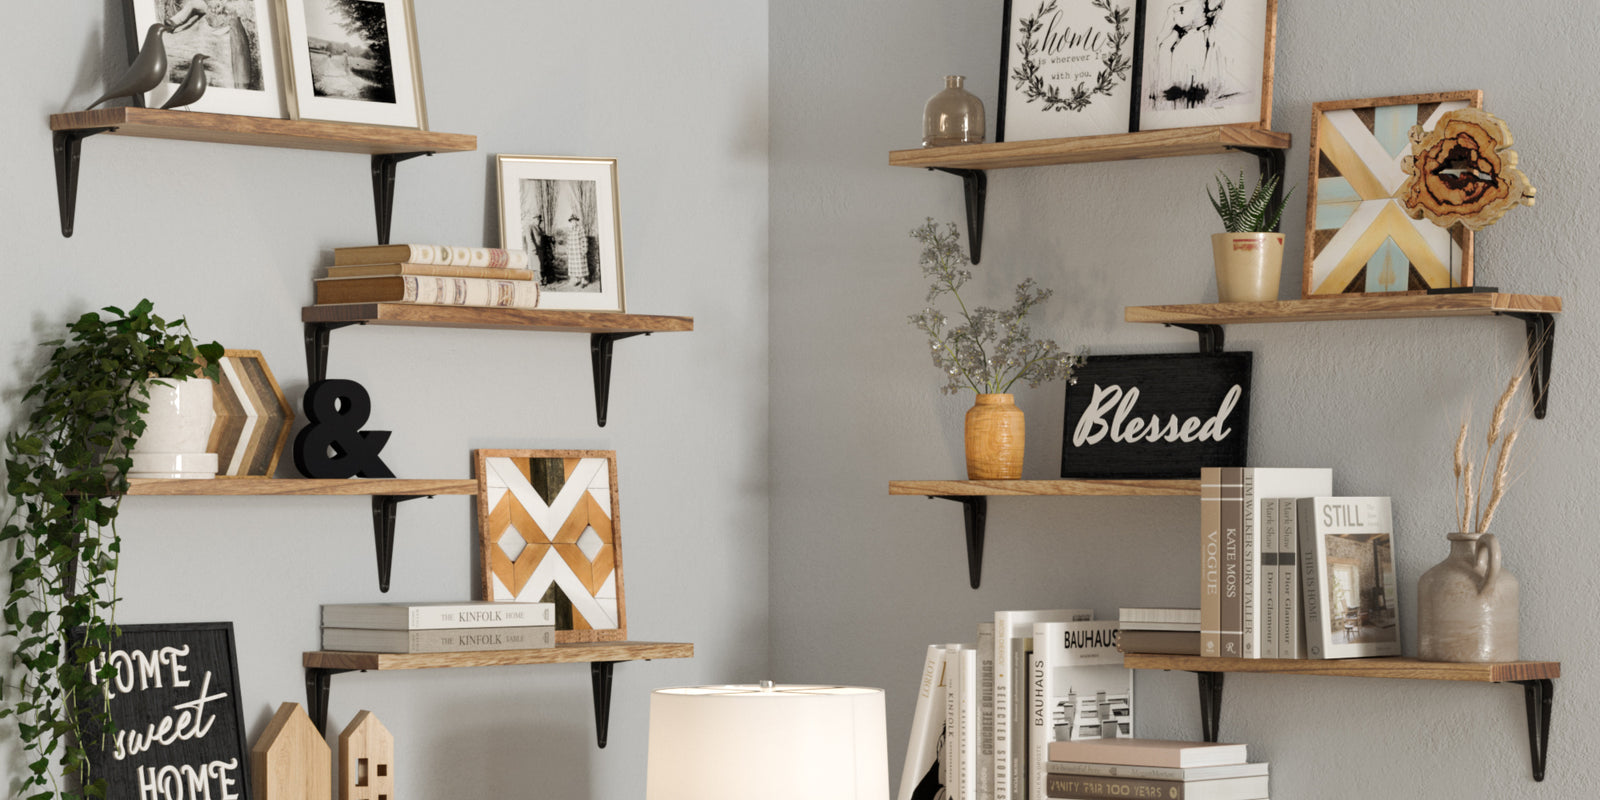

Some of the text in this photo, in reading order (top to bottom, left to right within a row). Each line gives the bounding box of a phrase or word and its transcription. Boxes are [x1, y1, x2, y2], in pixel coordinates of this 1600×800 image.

[1041, 9, 1104, 56] home
[1051, 54, 1091, 64] wherever
[1051, 71, 1092, 82] with you.
[1073, 383, 1242, 448] Blessed
[1266, 501, 1275, 525] Mark
[1283, 501, 1293, 525] Mark
[1323, 504, 1364, 528] STILL
[1207, 531, 1217, 595] VOGUE
[1226, 528, 1237, 598] KATE MOSS
[1246, 476, 1254, 635] TIM WALKER STORY TALLER
[1305, 551, 1315, 577] THIS
[1306, 578, 1315, 588] IS
[459, 611, 502, 622] KINFOLK
[1284, 598, 1292, 644] Glamour
[1307, 589, 1317, 623] HOME
[459, 635, 502, 646] KINFOLK
[1064, 629, 1119, 649] BAUHAUS
[922, 659, 936, 698] LORIOT
[1034, 660, 1044, 727] BAUHAUS
[113, 671, 228, 760] sweet
[982, 711, 993, 756] CONCRETE
[997, 685, 1006, 800] SELECTED STORIES
[137, 757, 239, 800] HOME
[1050, 779, 1162, 798] VANITY FAIR 100 YEARS
